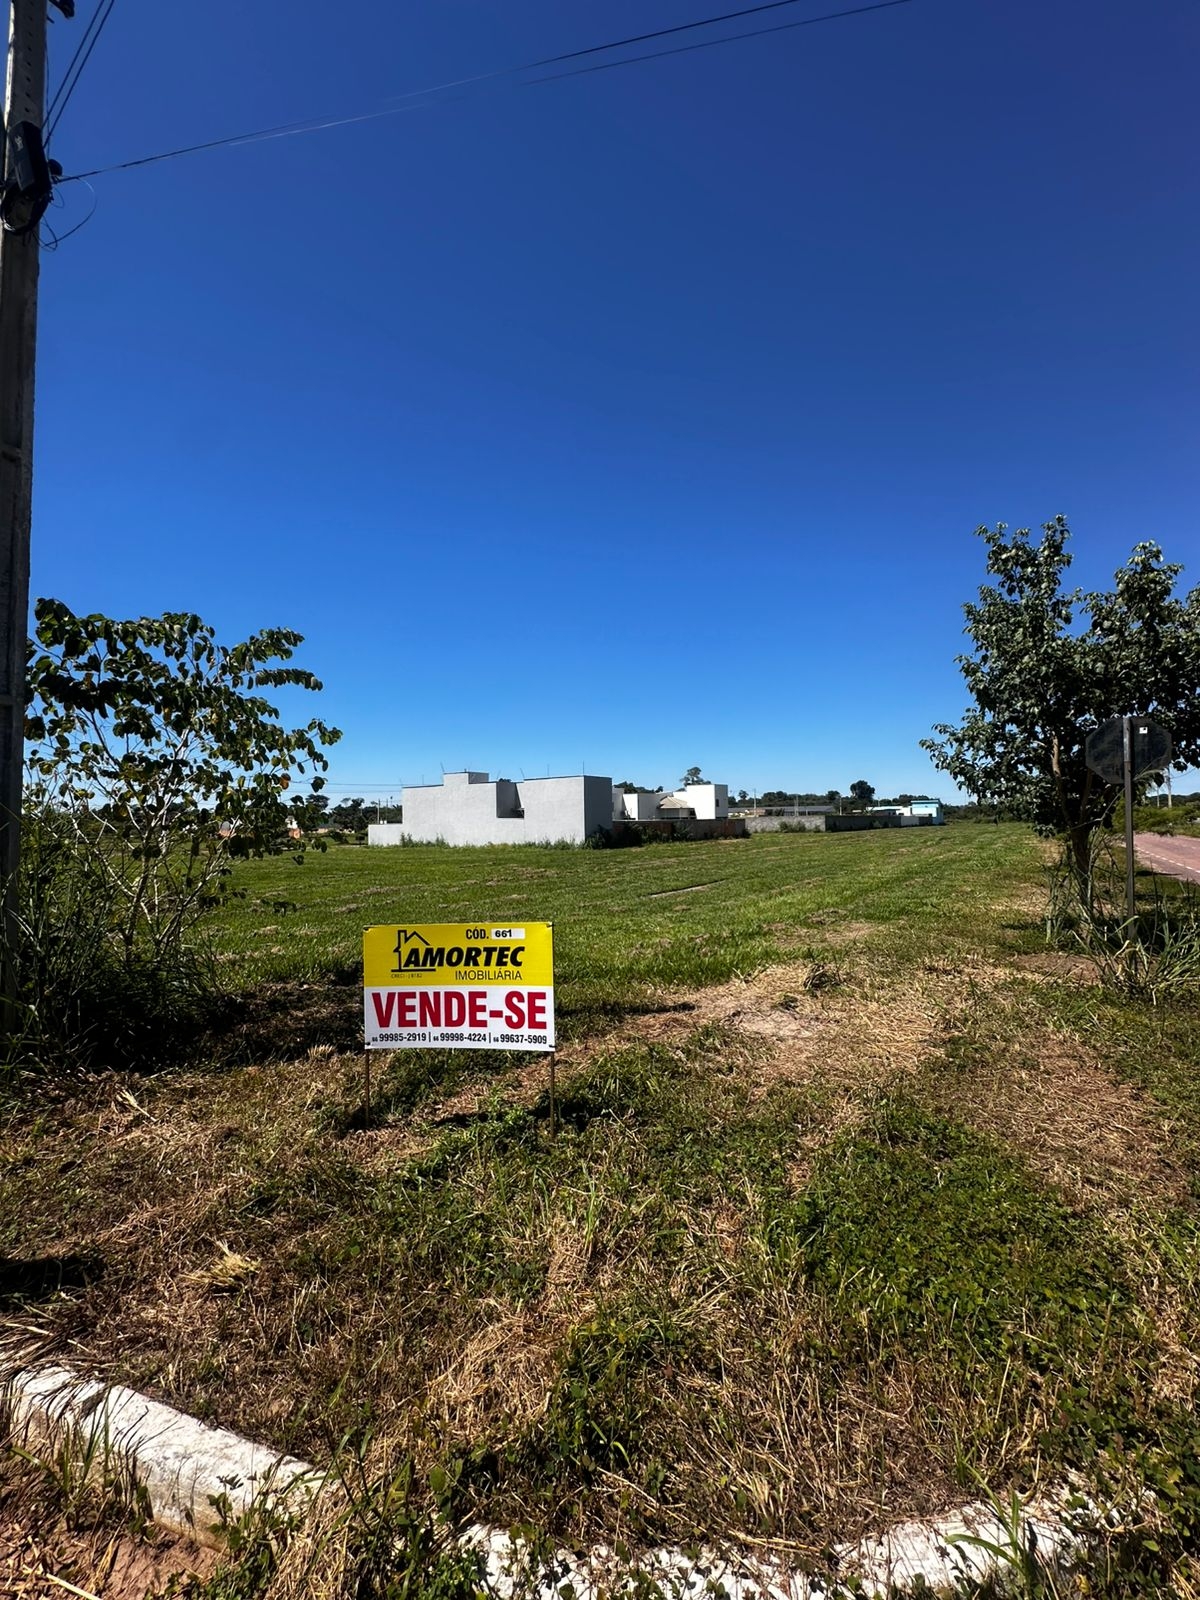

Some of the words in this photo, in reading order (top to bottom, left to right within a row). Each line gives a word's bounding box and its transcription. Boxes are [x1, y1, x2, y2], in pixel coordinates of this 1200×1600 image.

[466, 926, 489, 940] CÓD.
[495, 928, 512, 938] 661
[403, 946, 525, 968] AMORTEC
[455, 967, 523, 981] IMOBILIÁRIA
[371, 990, 547, 1030] VENDE-SE
[378, 1032, 427, 1042] 99985-2919
[440, 1032, 487, 1042] 99998-4224
[500, 1033, 547, 1045] 99637-5909
